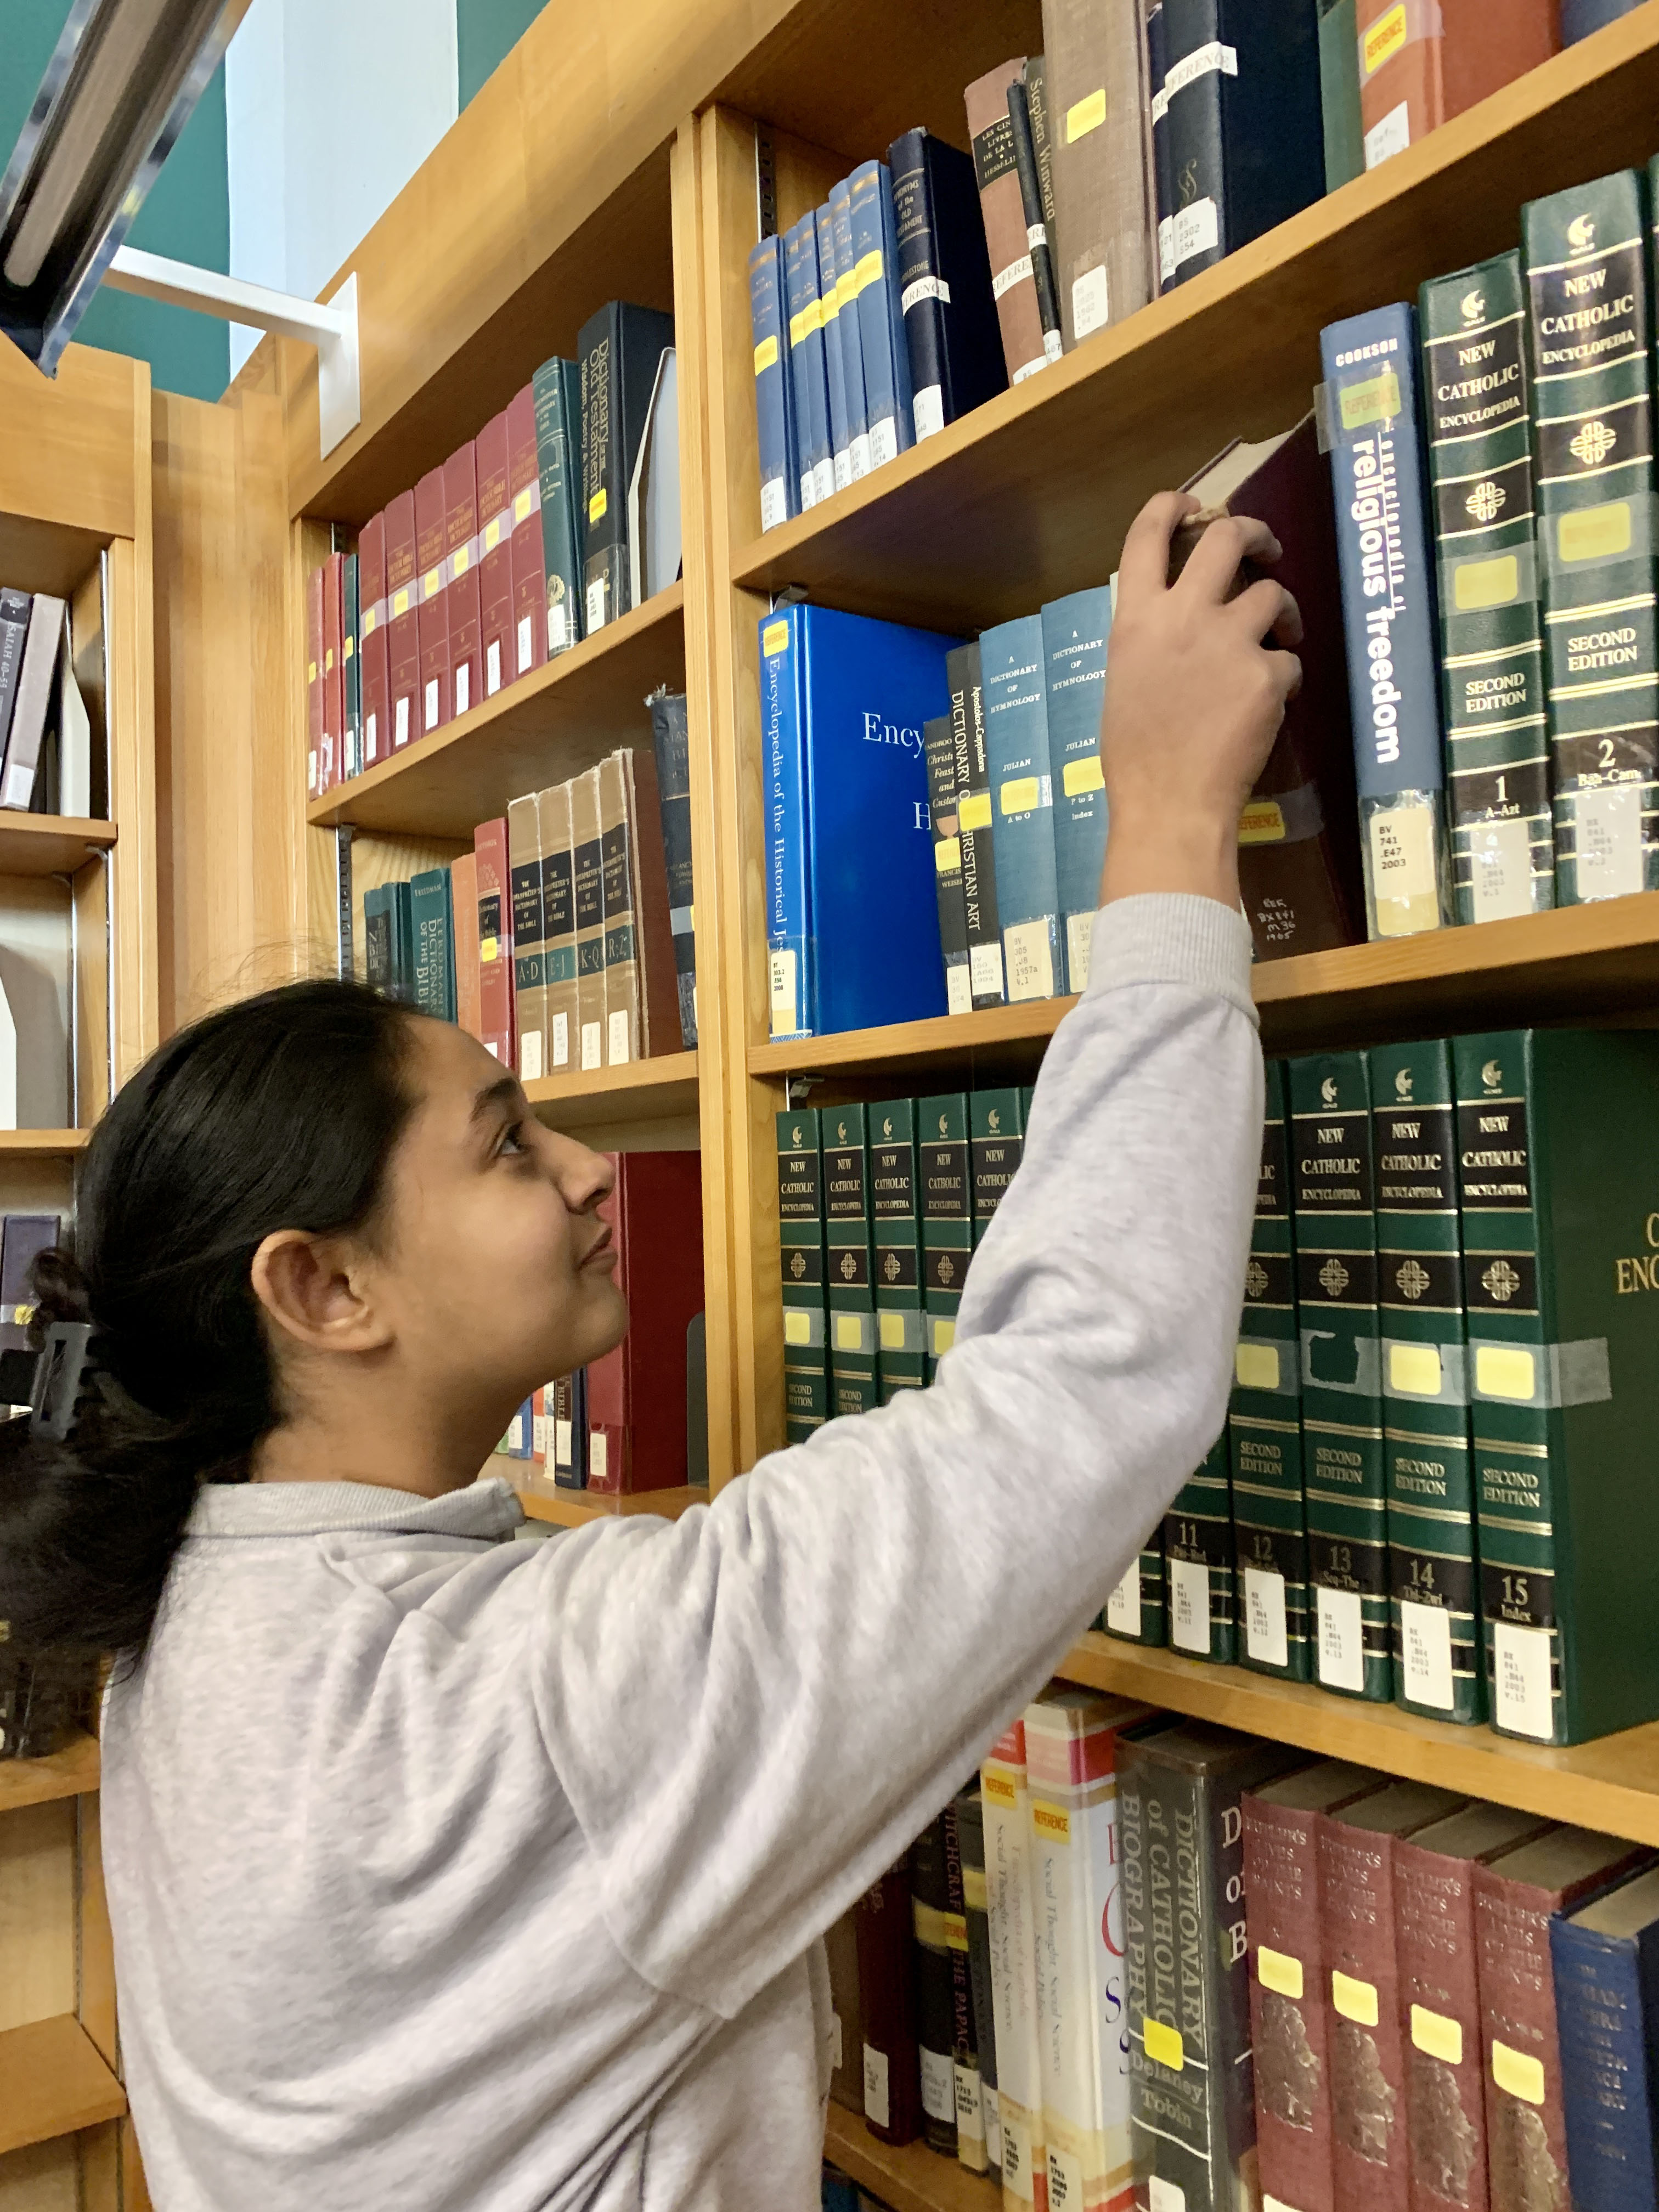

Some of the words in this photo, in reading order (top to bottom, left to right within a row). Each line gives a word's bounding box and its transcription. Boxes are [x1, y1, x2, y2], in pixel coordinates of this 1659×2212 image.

[1029, 77, 1047, 144] Stephen
[1565, 269, 1606, 297] NEW
[1541, 295, 1634, 335] CATHOLIC
[1336, 338, 1398, 368] COOKSON
[1459, 341, 1496, 366] NEW
[1542, 329, 1635, 365] ENCYCLOPEDIA
[590, 348, 600, 388] Old
[599, 337, 609, 442] Dictionary
[1437, 364, 1519, 402] CATHOLIC
[1440, 396, 1520, 429] ENCYCLOPEDIA
[590, 388, 600, 493] Testament
[1351, 440, 1386, 597] religious
[1380, 440, 1406, 584] encyclopedia
[1053, 639, 1103, 660] DICTIONARY
[1568, 628, 1637, 652] SECOND
[1070, 660, 1081, 669] OF
[1568, 646, 1638, 672] EDITION
[990, 664, 1037, 684] DICTIONARY
[1053, 670, 1106, 691] HYMNOLOGY
[1366, 606, 1402, 763] freedom
[1465, 673, 1525, 696] SECOND
[1007, 685, 1018, 693] OF
[991, 693, 1040, 714] HYMNOLOGY
[1466, 689, 1526, 713] EDITION
[768, 658, 785, 778] Encyclopedia
[952, 690, 969, 785] DICTIONARY
[971, 686, 985, 772] Apostolos-Cappadona
[1065, 738, 1096, 752] JULIAN
[1599, 739, 1616, 768] 2
[1003, 759, 1031, 772] JULIAN
[774, 782, 785, 800] of
[939, 780, 954, 792] and
[1496, 776, 1509, 802] 1
[774, 804, 785, 832] the
[1072, 810, 1093, 820] Index
[1379, 826, 1392, 834] BV
[1380, 837, 1397, 845] 741
[1380, 847, 1402, 858] .E47
[1381, 859, 1407, 870] 2003
[774, 839, 787, 924] Historical
[967, 902, 980, 930] ART
[420, 921, 427, 933] OF
[1015, 946, 1027, 956] 305
[1016, 966, 1038, 977] 1957a
[1391, 1122, 1420, 1139] NEW
[1479, 1116, 1510, 1132] NEW
[1317, 1127, 1344, 1144] NEW
[790, 1161, 805, 1172] NEW
[837, 1158, 851, 1170] NEW
[882, 1155, 896, 1167] NEW
[937, 1154, 951, 1166] NEW
[985, 1150, 1005, 1162] NEW
[1381, 1155, 1441, 1171] CATHOLIC
[1462, 1150, 1526, 1167] CATHOLIC
[1301, 1159, 1361, 1175] CATHOLIC
[781, 1182, 814, 1194] CATHOLIC
[830, 1181, 860, 1192] CATHOLIC
[875, 1177, 909, 1190] CATHOLIC
[929, 1177, 961, 1189] CATHOLIC
[1240, 1441, 1281, 1459] SECOND
[1317, 1447, 1362, 1466] SECOND
[1240, 1457, 1282, 1476] EDITION
[1317, 1464, 1363, 1483] EDITION
[1395, 1457, 1444, 1477] SECOND
[1395, 1474, 1446, 1496] EDITION
[1483, 1468, 1539, 1488] SECOND
[1483, 1487, 1540, 1508] EDITION
[1180, 1522, 1199, 1547] 11
[1253, 1536, 1273, 1561] 12
[1330, 1545, 1352, 1573] 13
[1410, 1559, 1435, 1589] 14
[1502, 1575, 1528, 1606] 15
[1501, 1605, 1532, 1623] Index
[985, 1777, 1014, 1799] REFERENCE
[1035, 1809, 1068, 1832] REFERENCE
[1148, 1800, 1169, 1837] of
[1121, 1790, 1147, 2018] BIOGRAPHY
[1150, 1844, 1178, 2030] CATHOLIC
[1175, 1809, 1203, 2049] DICTIONARY
[1141, 2088, 1192, 2130] Tobin
